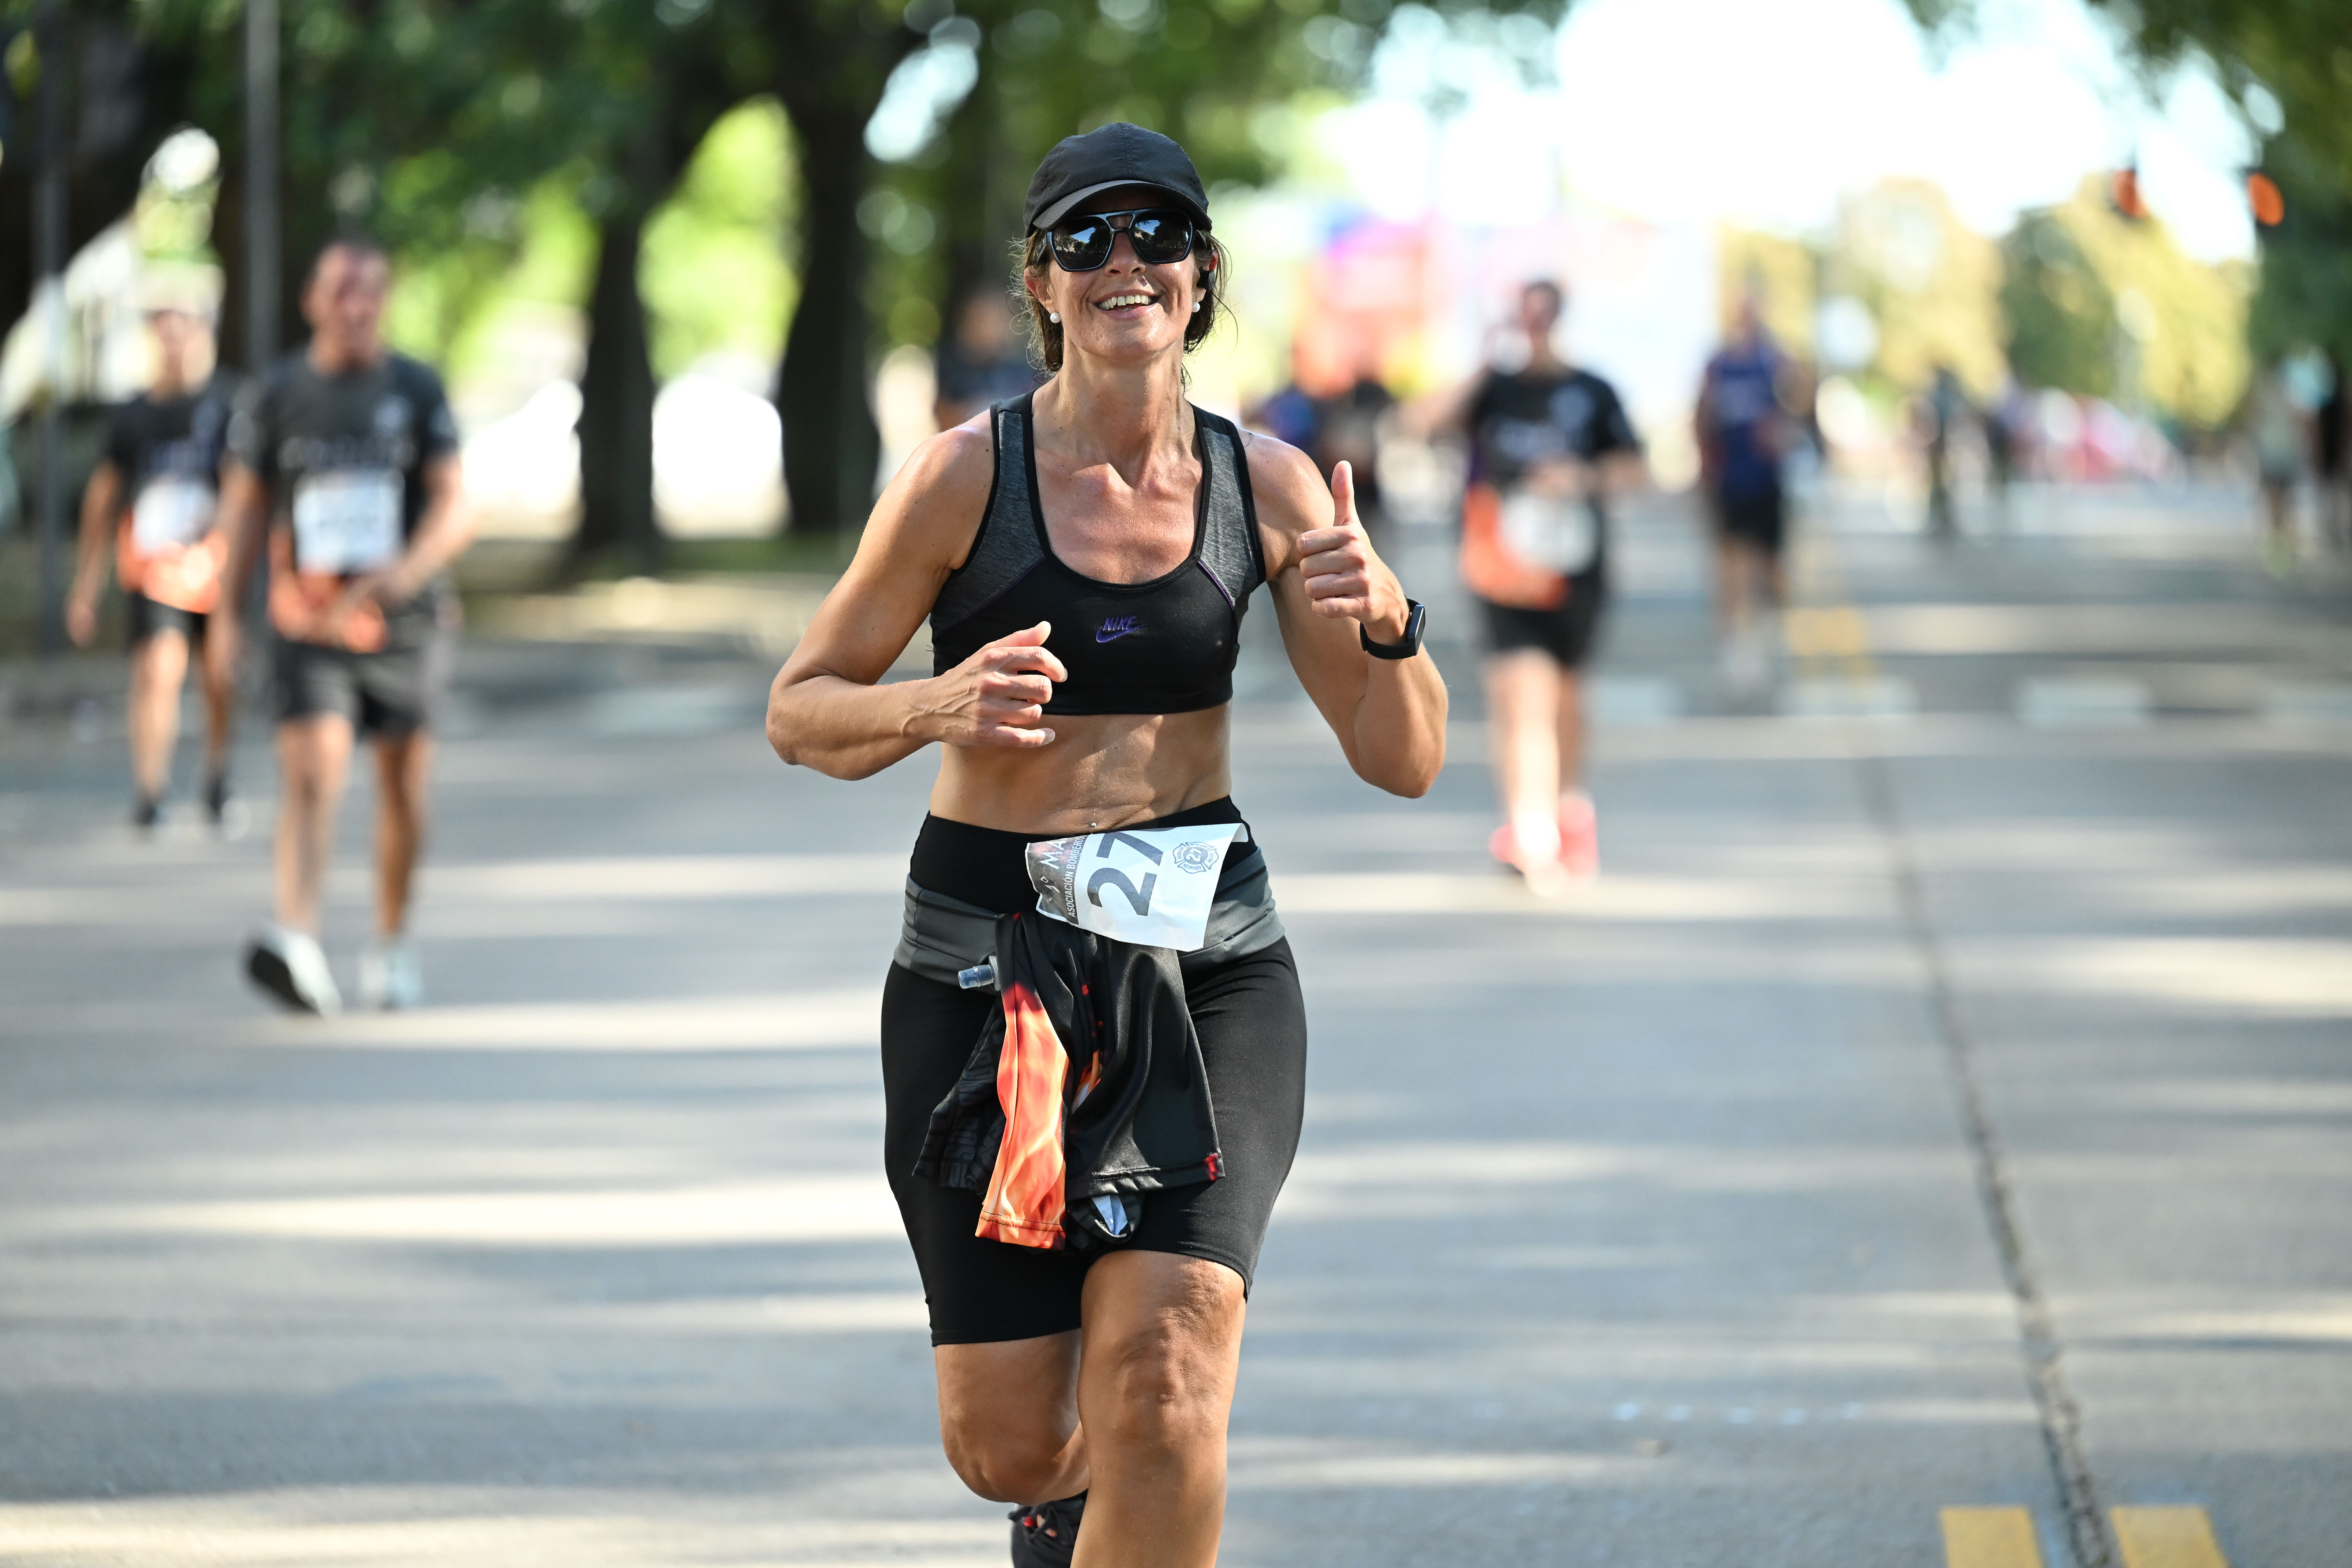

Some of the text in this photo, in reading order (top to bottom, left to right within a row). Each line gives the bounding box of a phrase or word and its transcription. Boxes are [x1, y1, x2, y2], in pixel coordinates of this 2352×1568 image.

[1102, 616, 1137, 631] NIKE
[1039, 838, 1068, 870] MA
[1185, 848, 1202, 862] 27
[1062, 836, 1085, 917] ASOCIACIÓN BOMBEROS
[1087, 828, 1175, 917] 27
